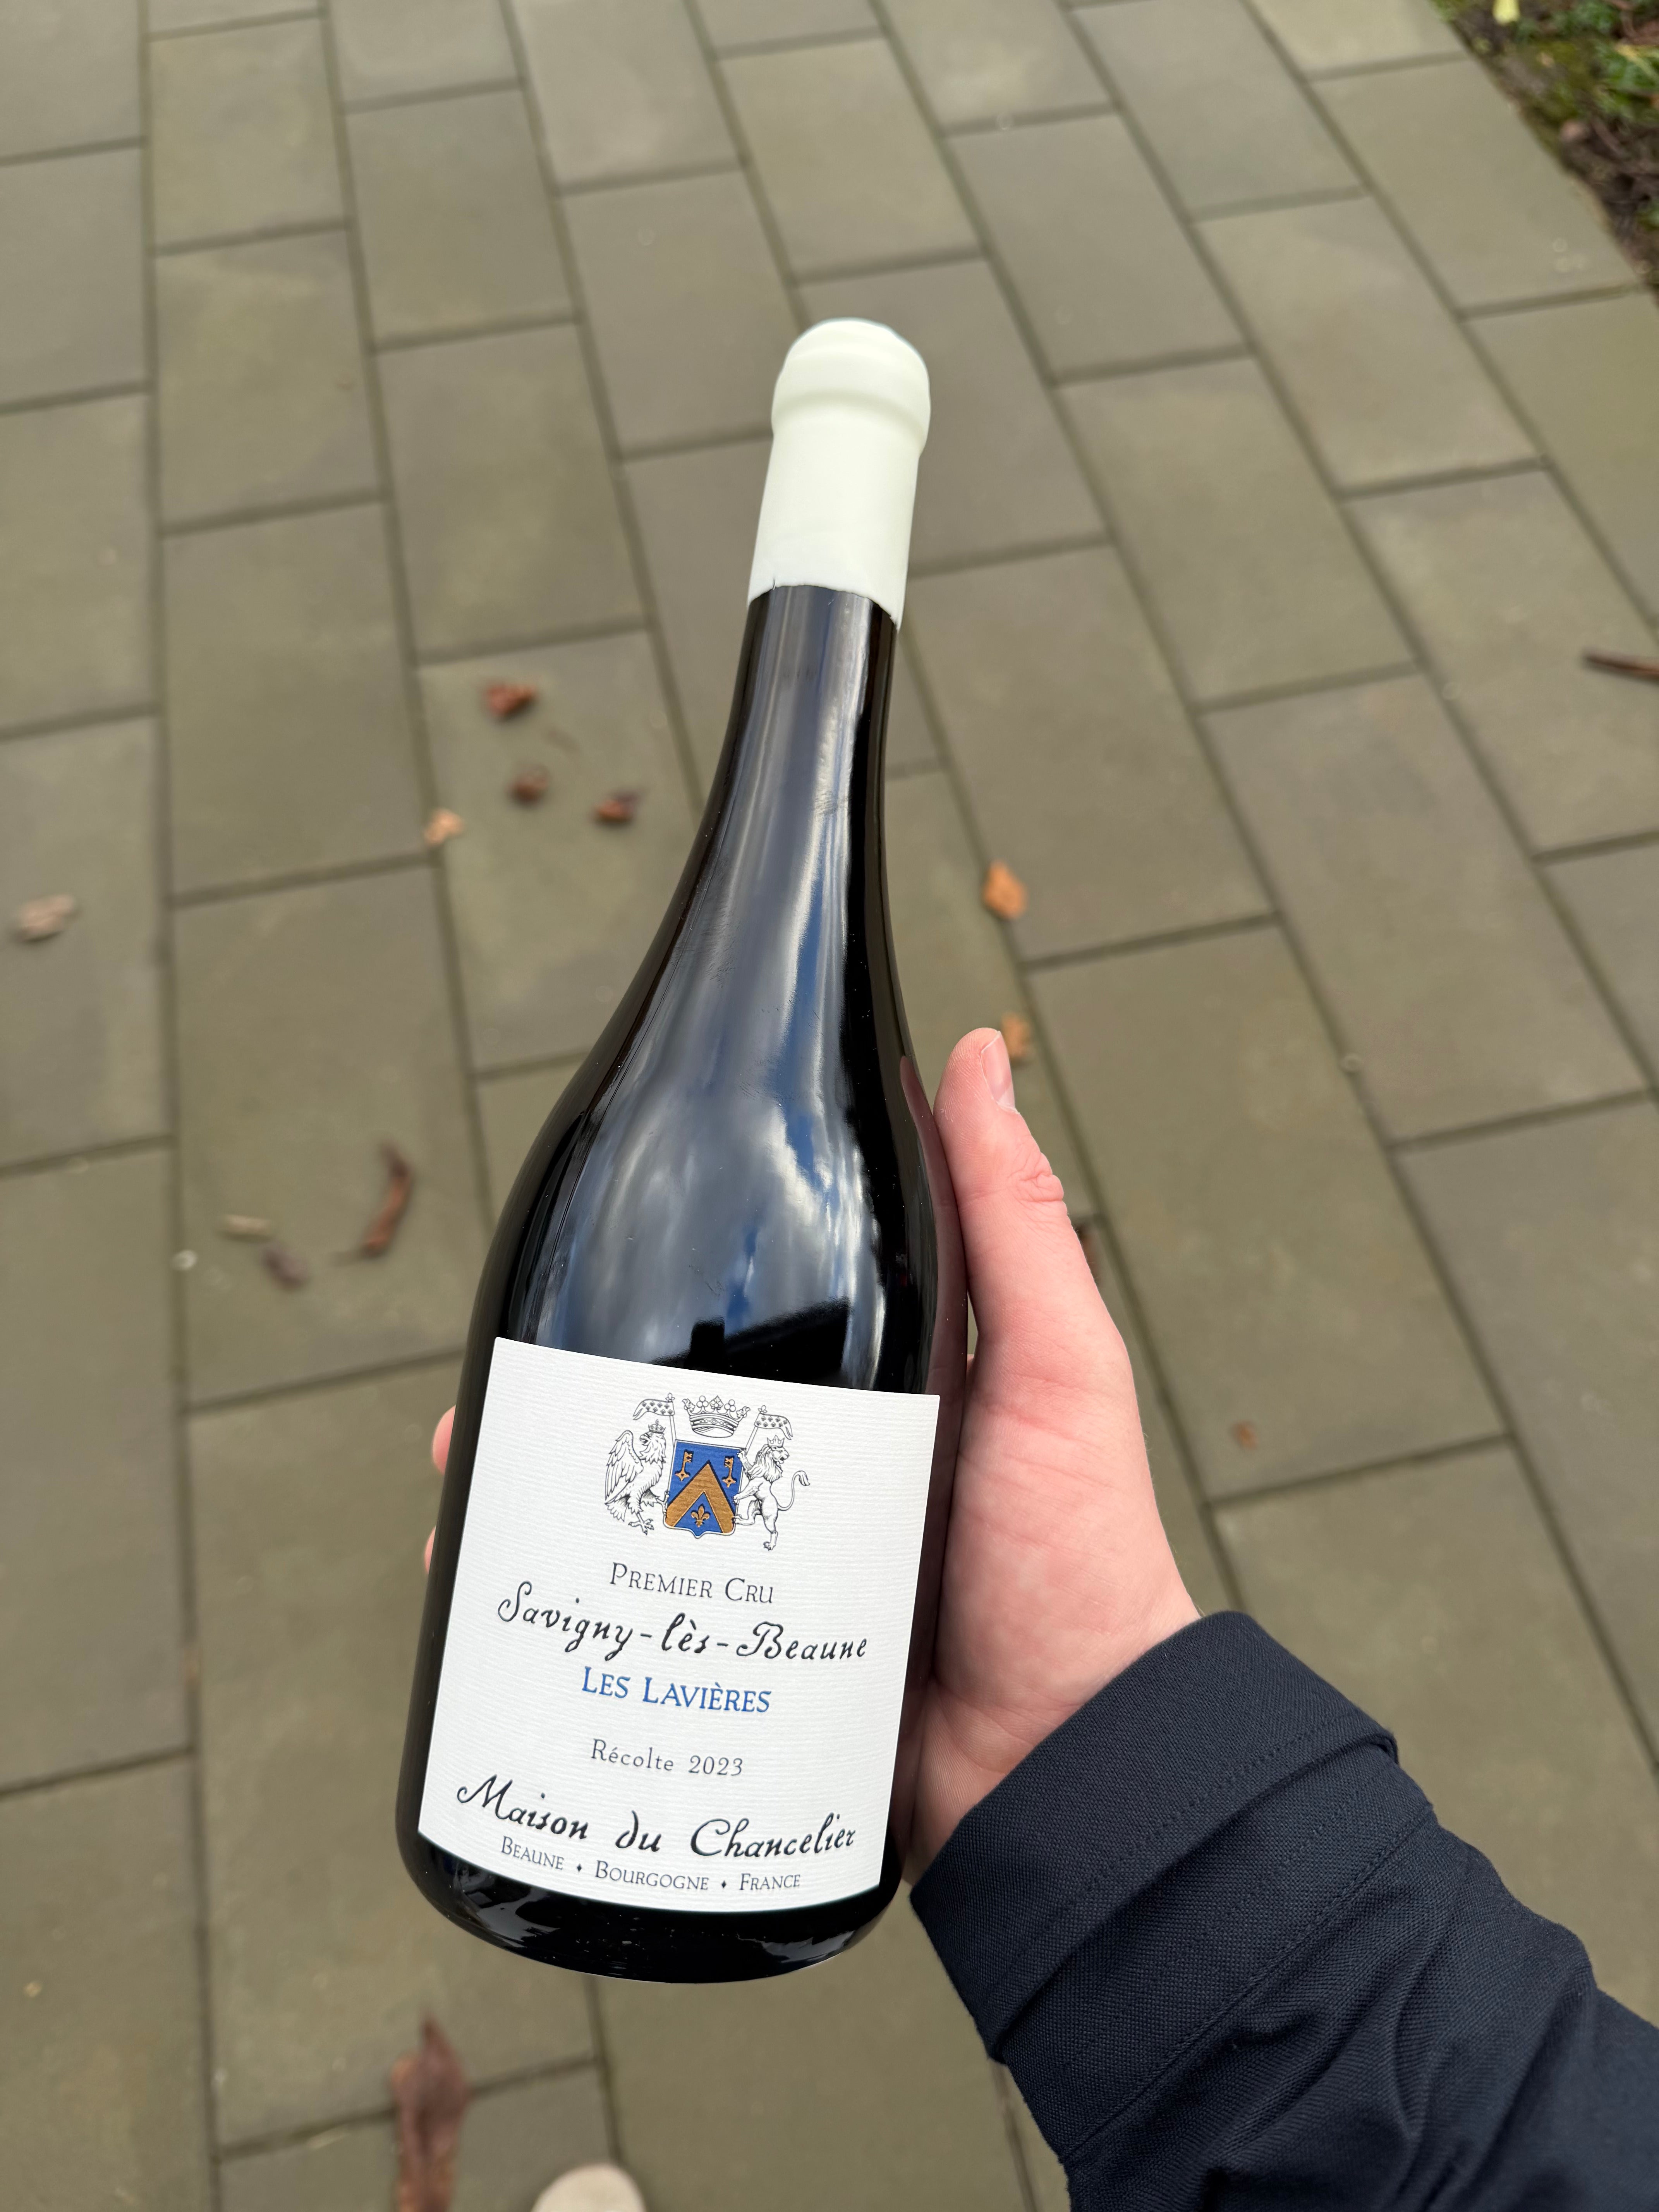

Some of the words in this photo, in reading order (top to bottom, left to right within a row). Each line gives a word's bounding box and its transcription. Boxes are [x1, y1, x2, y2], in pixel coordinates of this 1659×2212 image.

[610, 1561, 713, 1599] PREMIER
[725, 1577, 773, 1604] CRU
[497, 1580, 867, 1662] Savigny-lès-Beaune
[581, 1666, 631, 1699] LES
[642, 1676, 772, 1713] LAVIÈRES
[591, 1738, 674, 1772] Récolte
[688, 1755, 743, 1777] 2023
[456, 1774, 589, 1840] Maison
[614, 1810, 662, 1853] du
[690, 1812, 856, 1858] Chancelier
[501, 1835, 565, 1871] BEAUNE
[595, 1860, 709, 1891] BOURGOGNE
[739, 1873, 801, 1891] FRANCE
